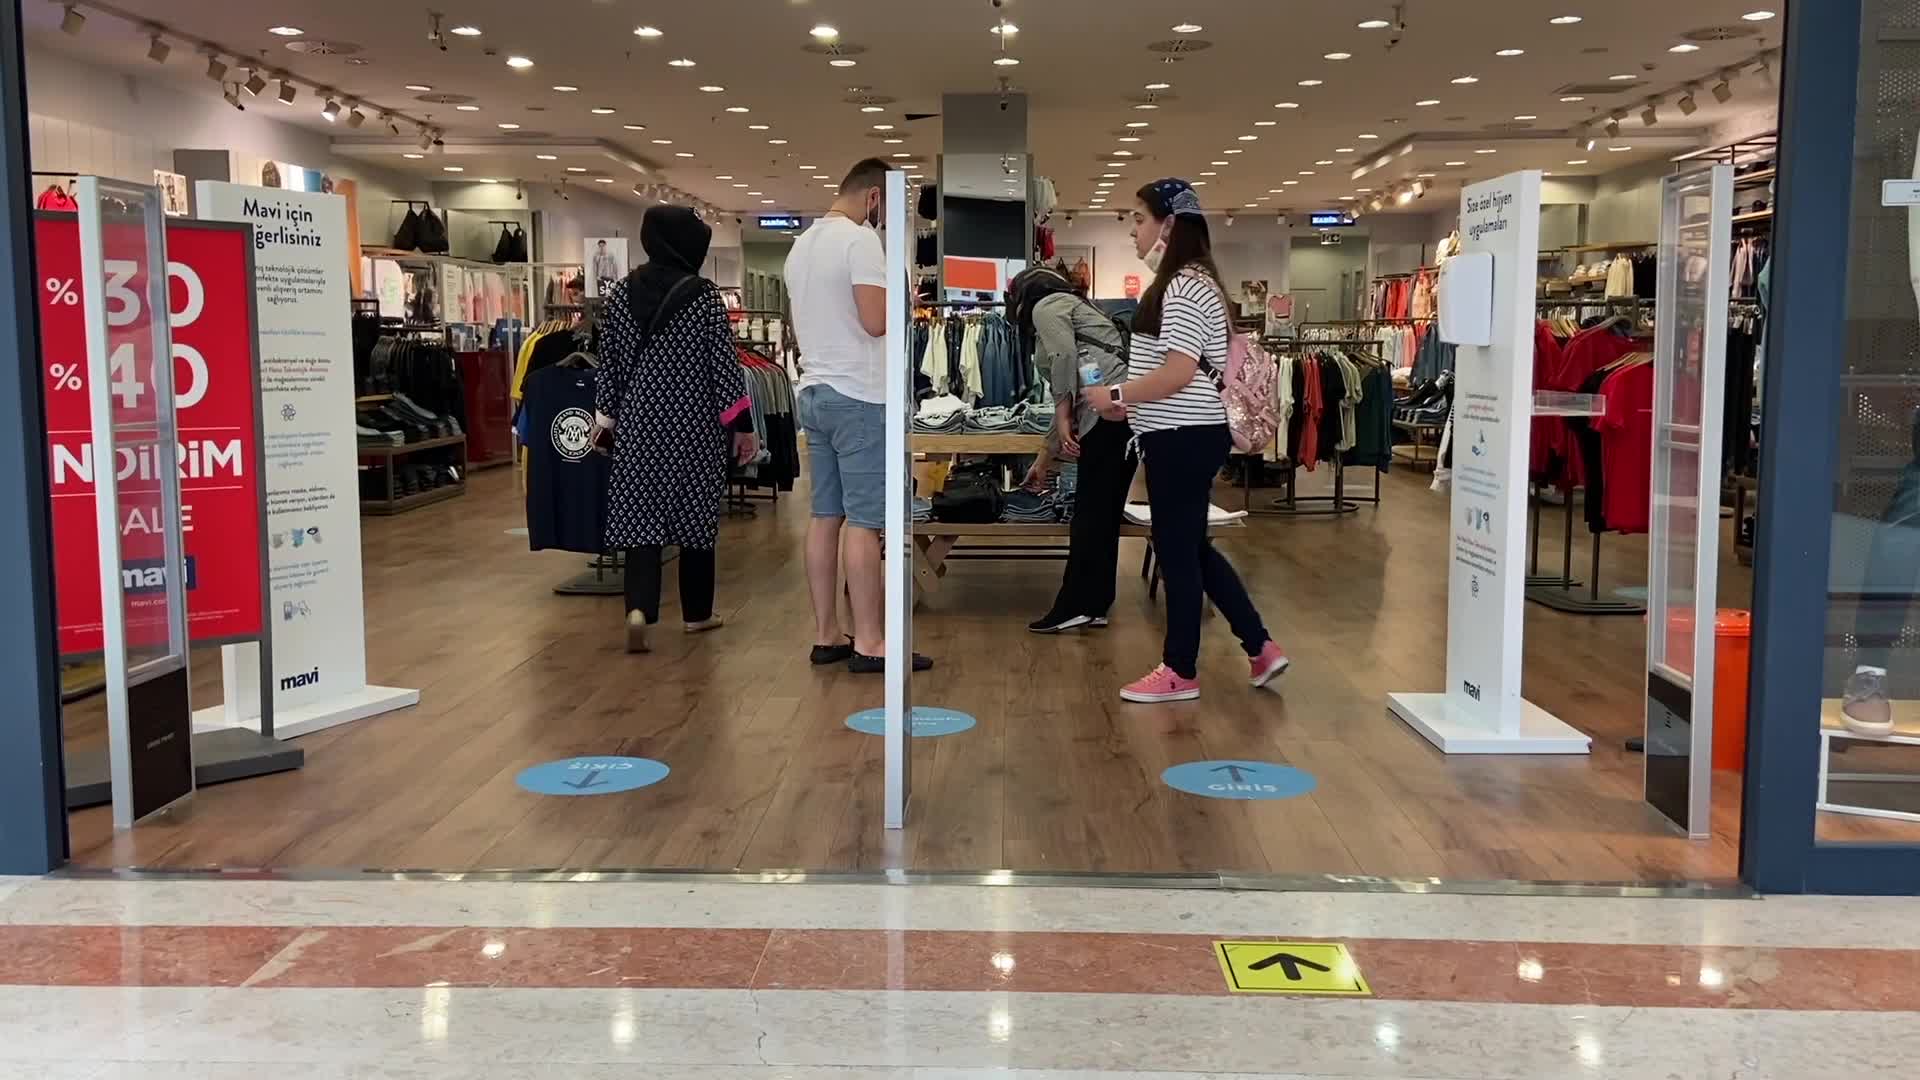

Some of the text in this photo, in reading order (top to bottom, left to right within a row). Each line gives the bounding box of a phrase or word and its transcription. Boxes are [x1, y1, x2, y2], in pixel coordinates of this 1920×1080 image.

[243, 197, 313, 227] Mavi için
[103, 259, 205, 328] 30
[110, 343, 209, 409] 40
[119, 505, 194, 536] ALE
[281, 666, 319, 690] mavi
[1464, 680, 1480, 702] mavi
